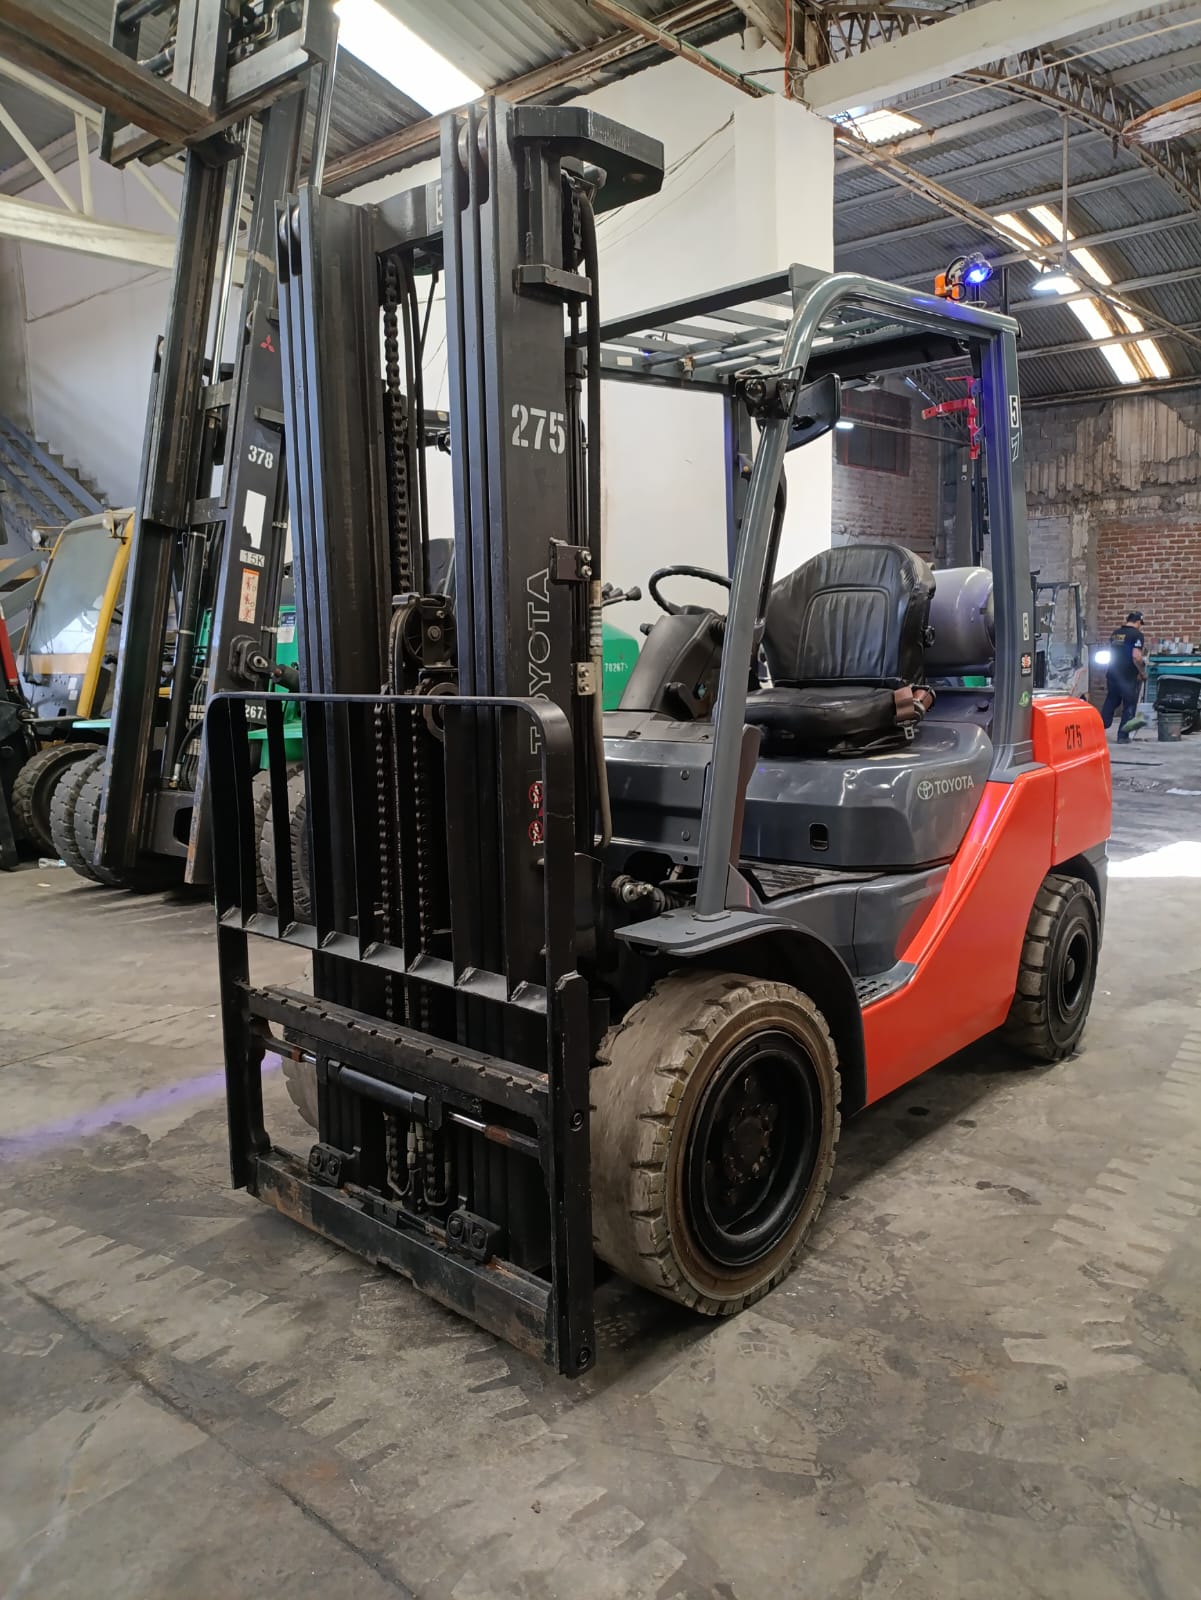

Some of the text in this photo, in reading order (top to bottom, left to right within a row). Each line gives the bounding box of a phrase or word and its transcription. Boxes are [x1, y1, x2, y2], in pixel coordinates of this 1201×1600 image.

[511, 404, 566, 454] 275
[248, 445, 273, 469] 378
[526, 568, 551, 754] TYOTA
[1065, 724, 1082, 750] 275
[935, 775, 975, 795] TOYOTA
